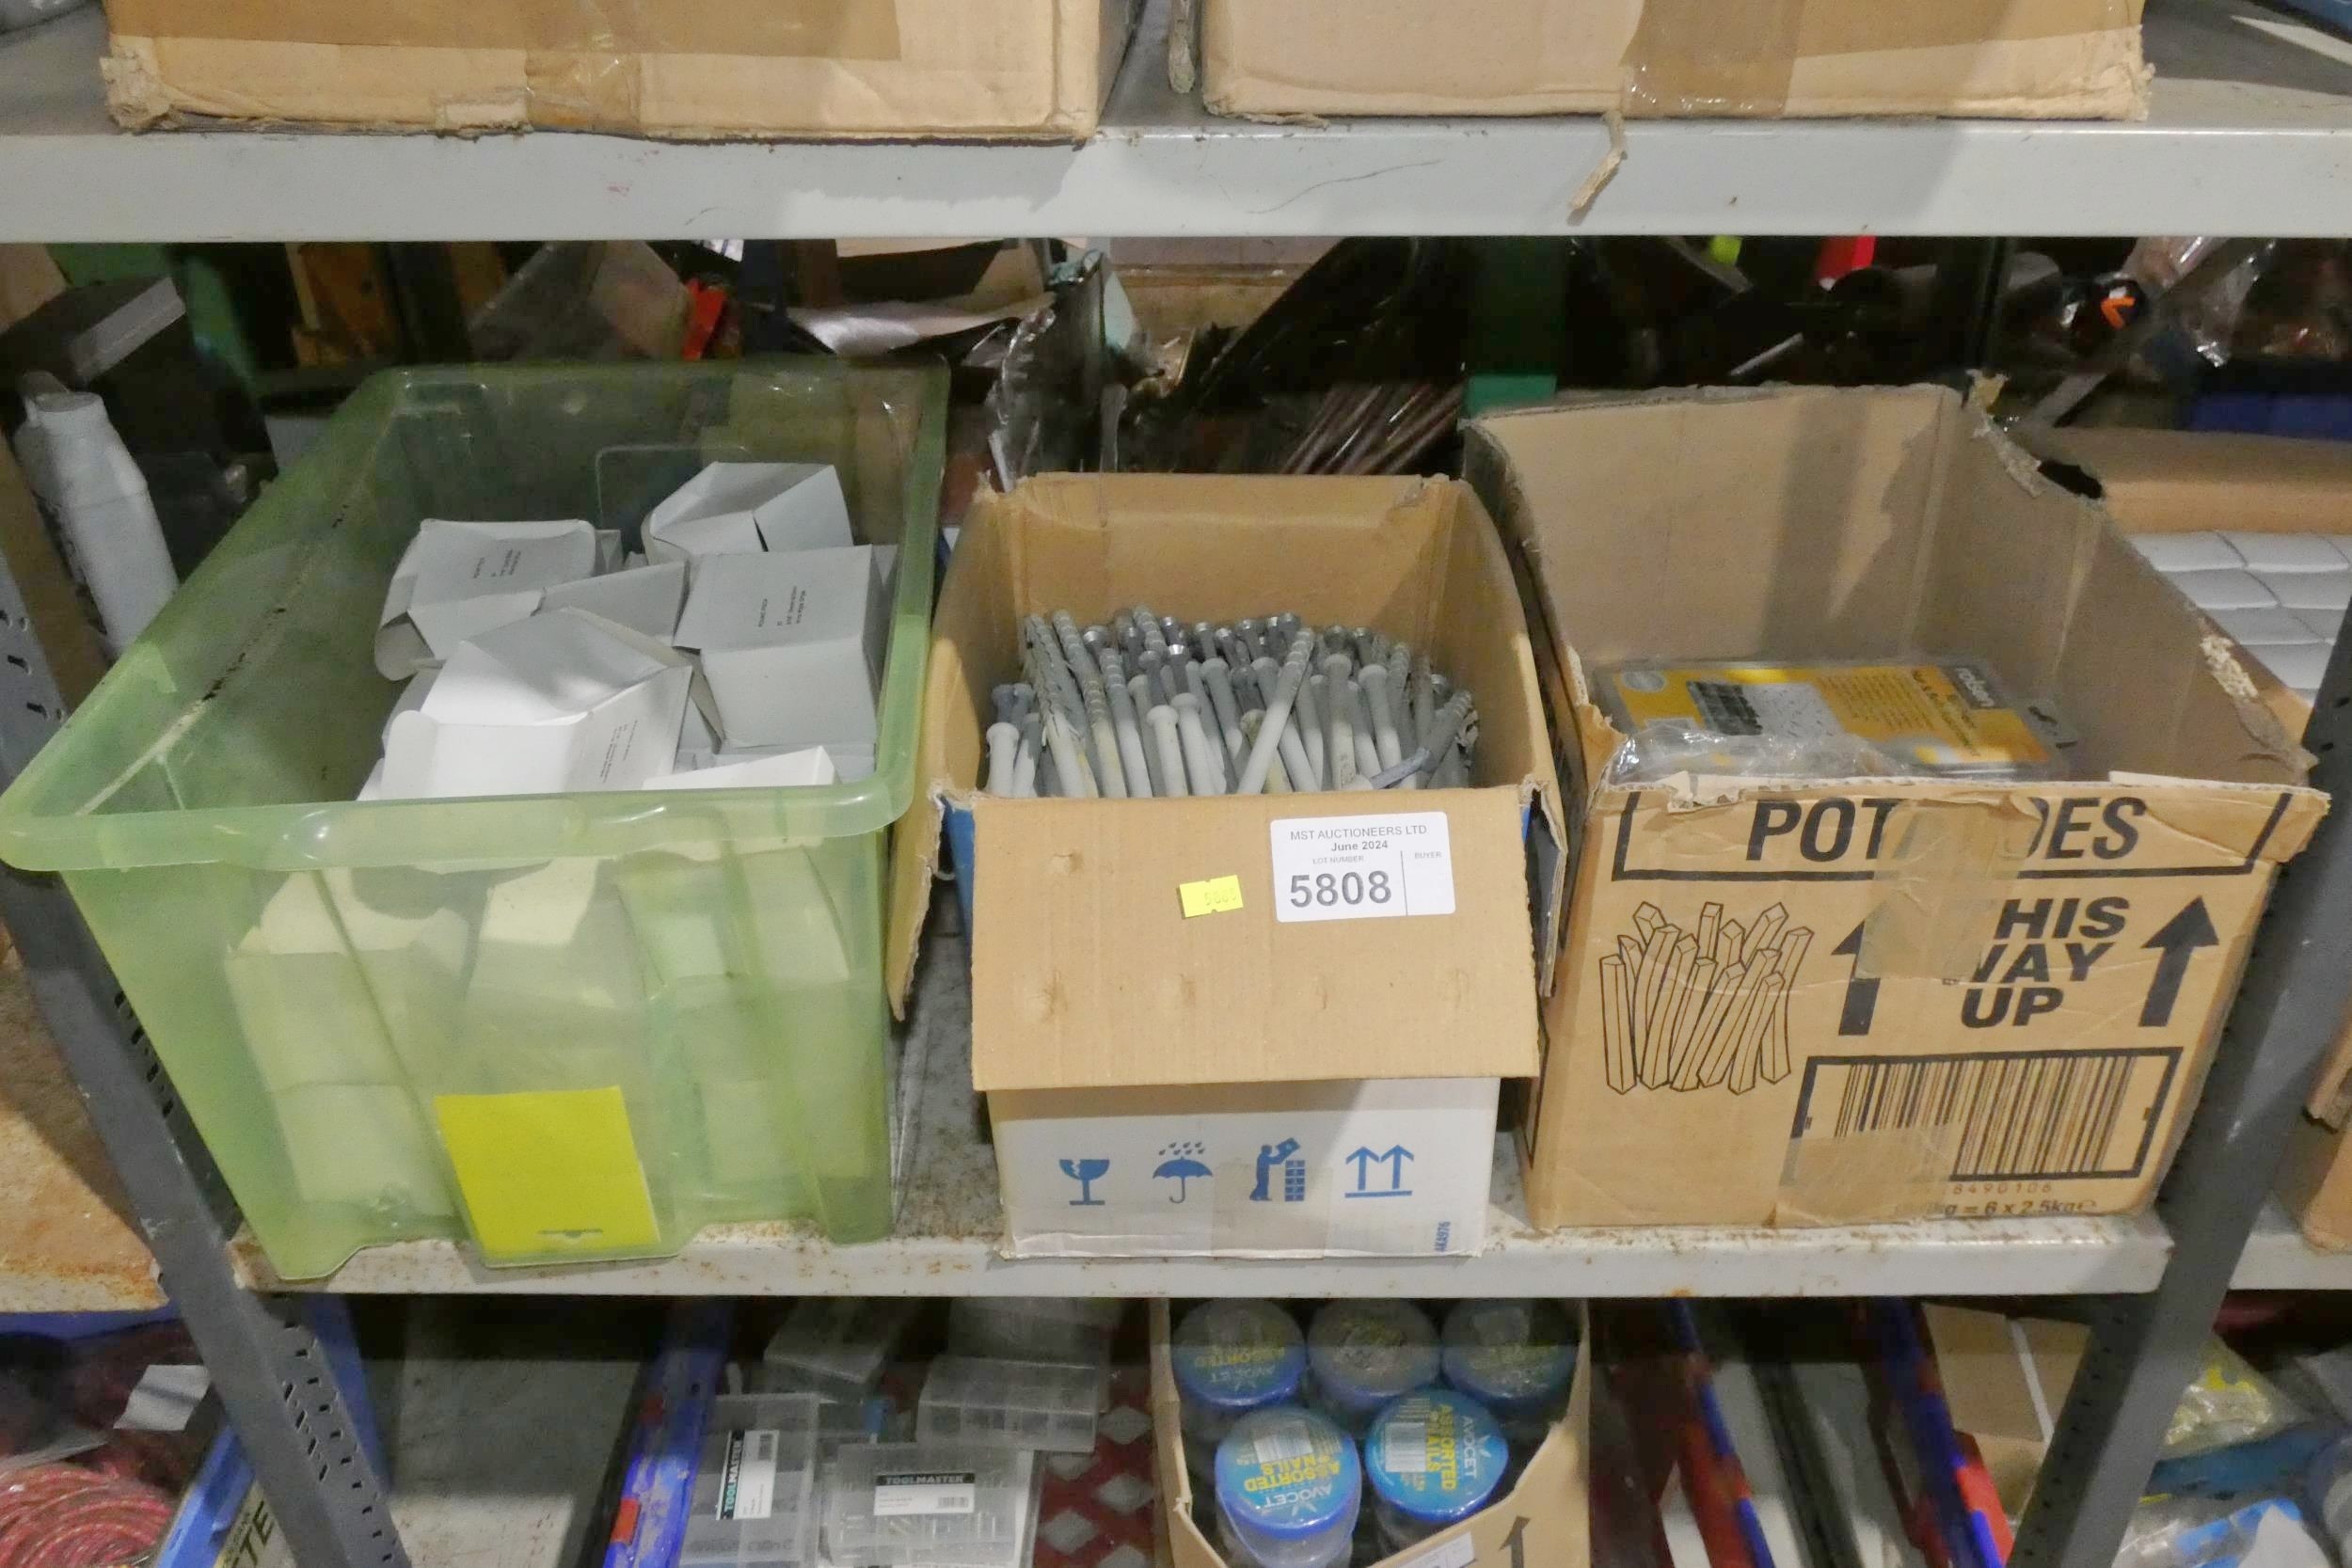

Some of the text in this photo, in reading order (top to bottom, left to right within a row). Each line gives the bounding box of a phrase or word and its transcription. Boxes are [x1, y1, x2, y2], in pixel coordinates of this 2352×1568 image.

[1290, 824, 1427, 841] MST AUCTIONEERS LTD
[1330, 839, 1389, 852] June 2024
[1745, 796, 2147, 863] POTES
[1329, 855, 1364, 863] NUMBER
[1414, 851, 1442, 860] BUYER
[1289, 870, 1392, 909] 5808
[1994, 895, 2131, 940] HIS
[1960, 987, 2065, 1029] UP
[1440, 1404, 1457, 1491] ASSORTED
[1462, 1416, 1477, 1479] AVOCET
[723, 1439, 742, 1513] TOOLMASTER
[885, 1474, 965, 1486] TOOLMASTER
[1244, 1461, 1341, 1493] ASSORTED
[1263, 1483, 1333, 1509] AVOCET
